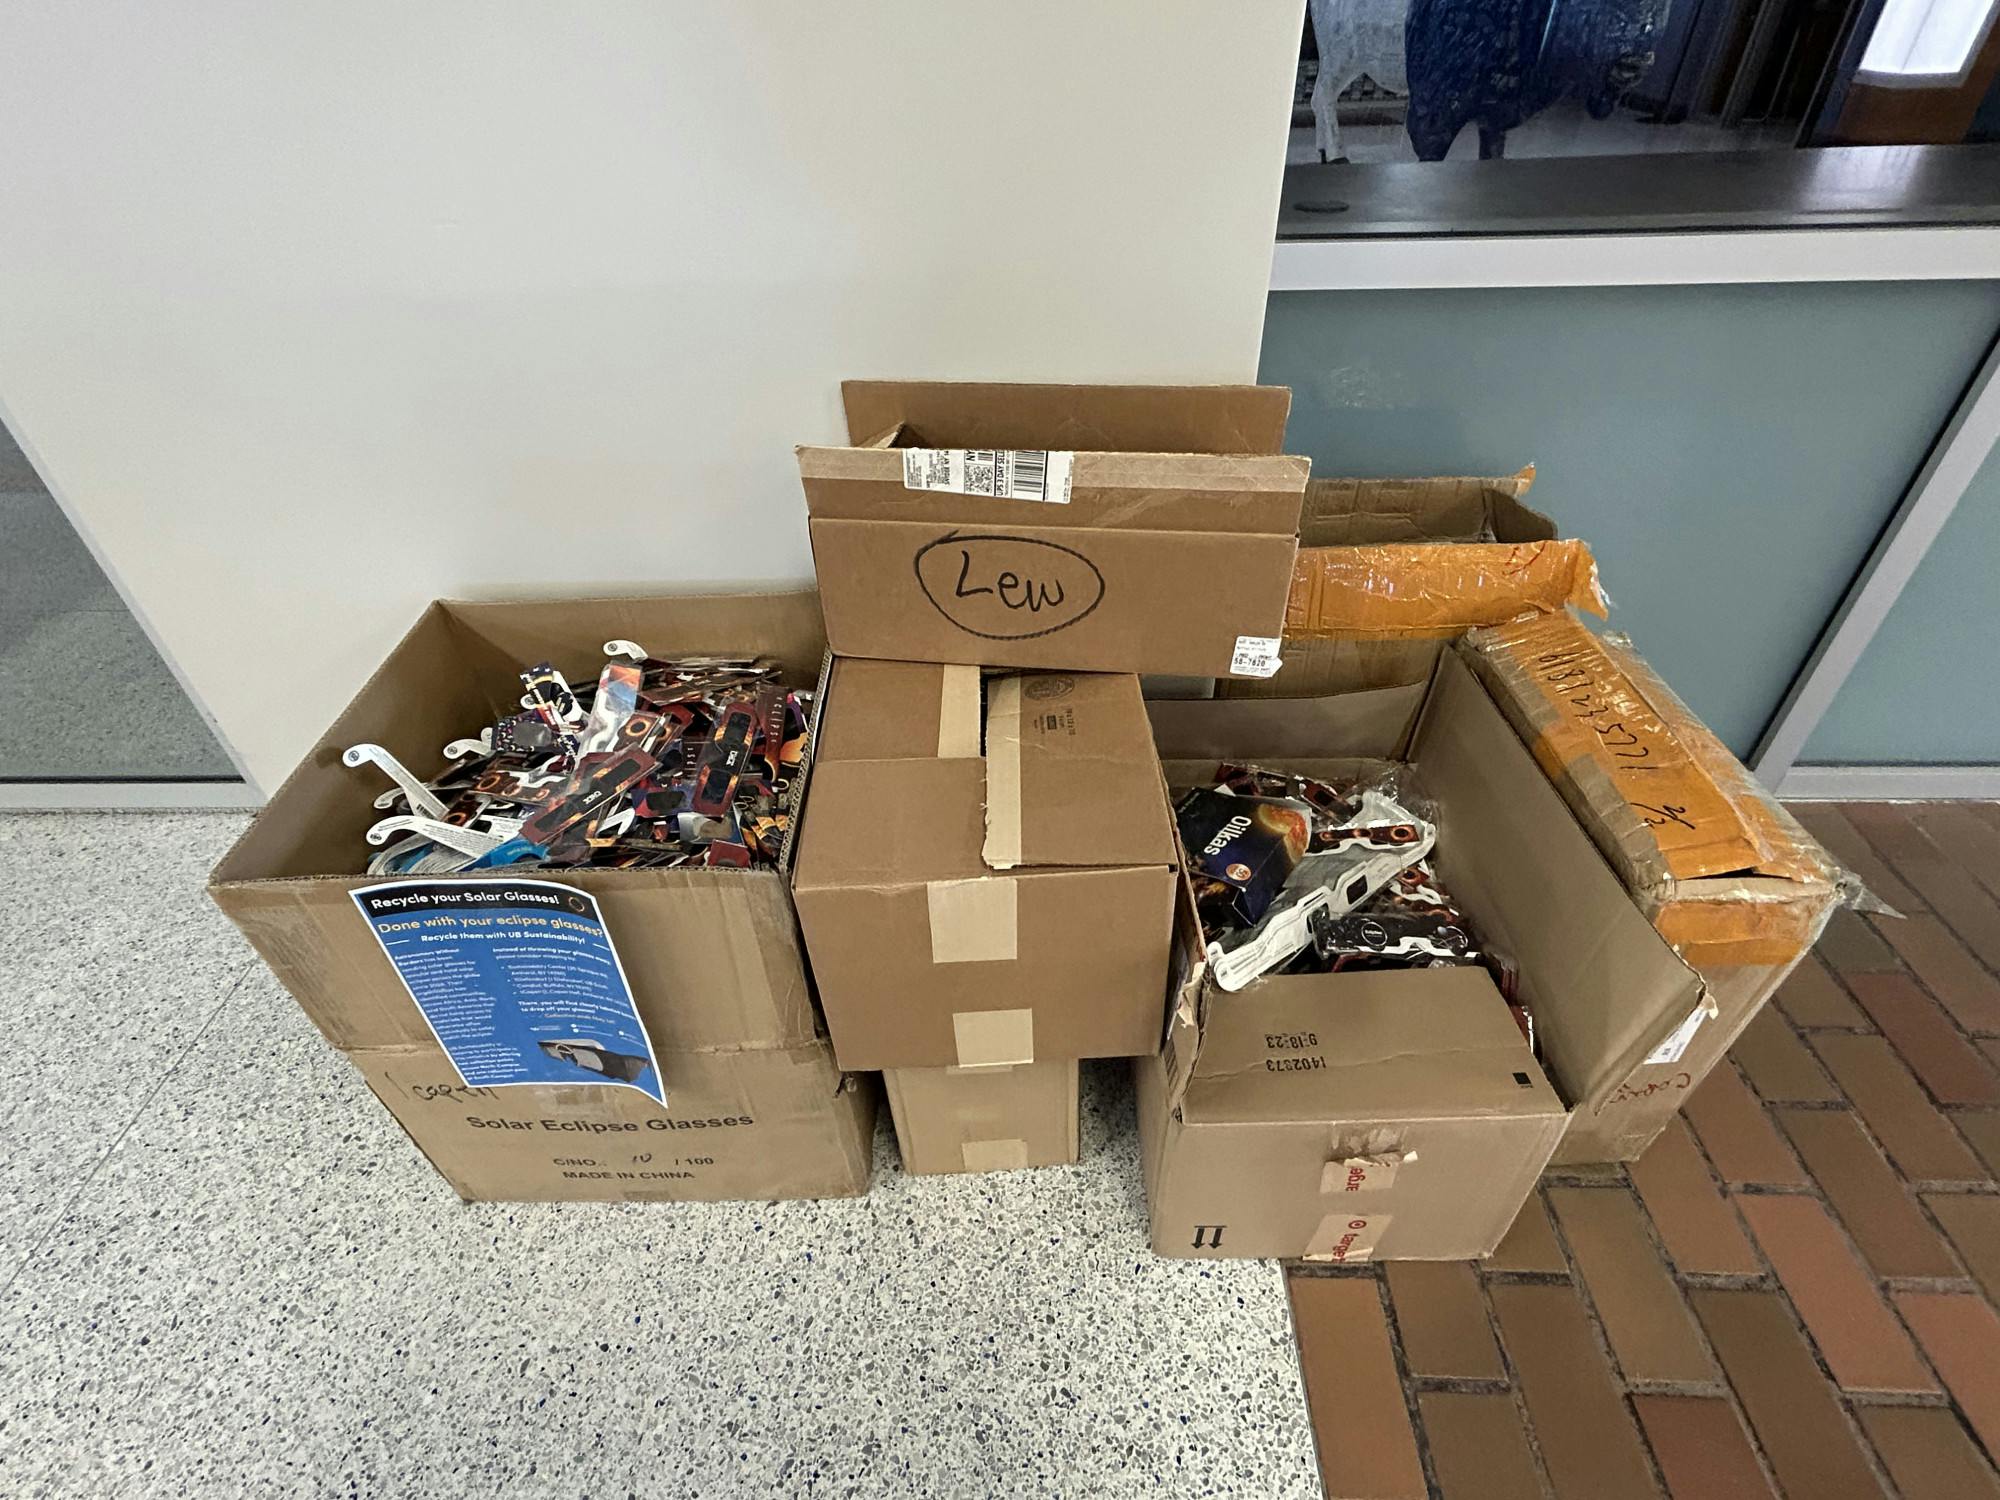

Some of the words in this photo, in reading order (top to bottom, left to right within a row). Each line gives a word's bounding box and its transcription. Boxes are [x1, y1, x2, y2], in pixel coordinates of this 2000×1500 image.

[955, 550, 1065, 613] Lew
[1203, 815, 1252, 855] Oilkas
[370, 893, 429, 909] Recycle
[430, 893, 461, 905] your
[463, 891, 501, 902] Solar
[503, 891, 560, 905] Glasses!
[378, 920, 421, 934] Done
[423, 916, 457, 928] with
[458, 917, 492, 928] your
[496, 915, 547, 928] eclipse
[550, 917, 603, 938] glasses?
[421, 932, 458, 942] Recycle
[459, 930, 484, 940] them
[485, 931, 507, 939] with
[508, 931, 522, 939] UB
[523, 931, 586, 945] Sustainability!
[466, 1116, 534, 1131] Solar
[540, 1118, 639, 1134] Eclipse
[645, 1114, 755, 1131] Glasses
[684, 1156, 715, 1165] 100
[562, 1171, 614, 1179] MADE
[615, 1171, 636, 1179] IN
[638, 1171, 696, 1179] CHINA
